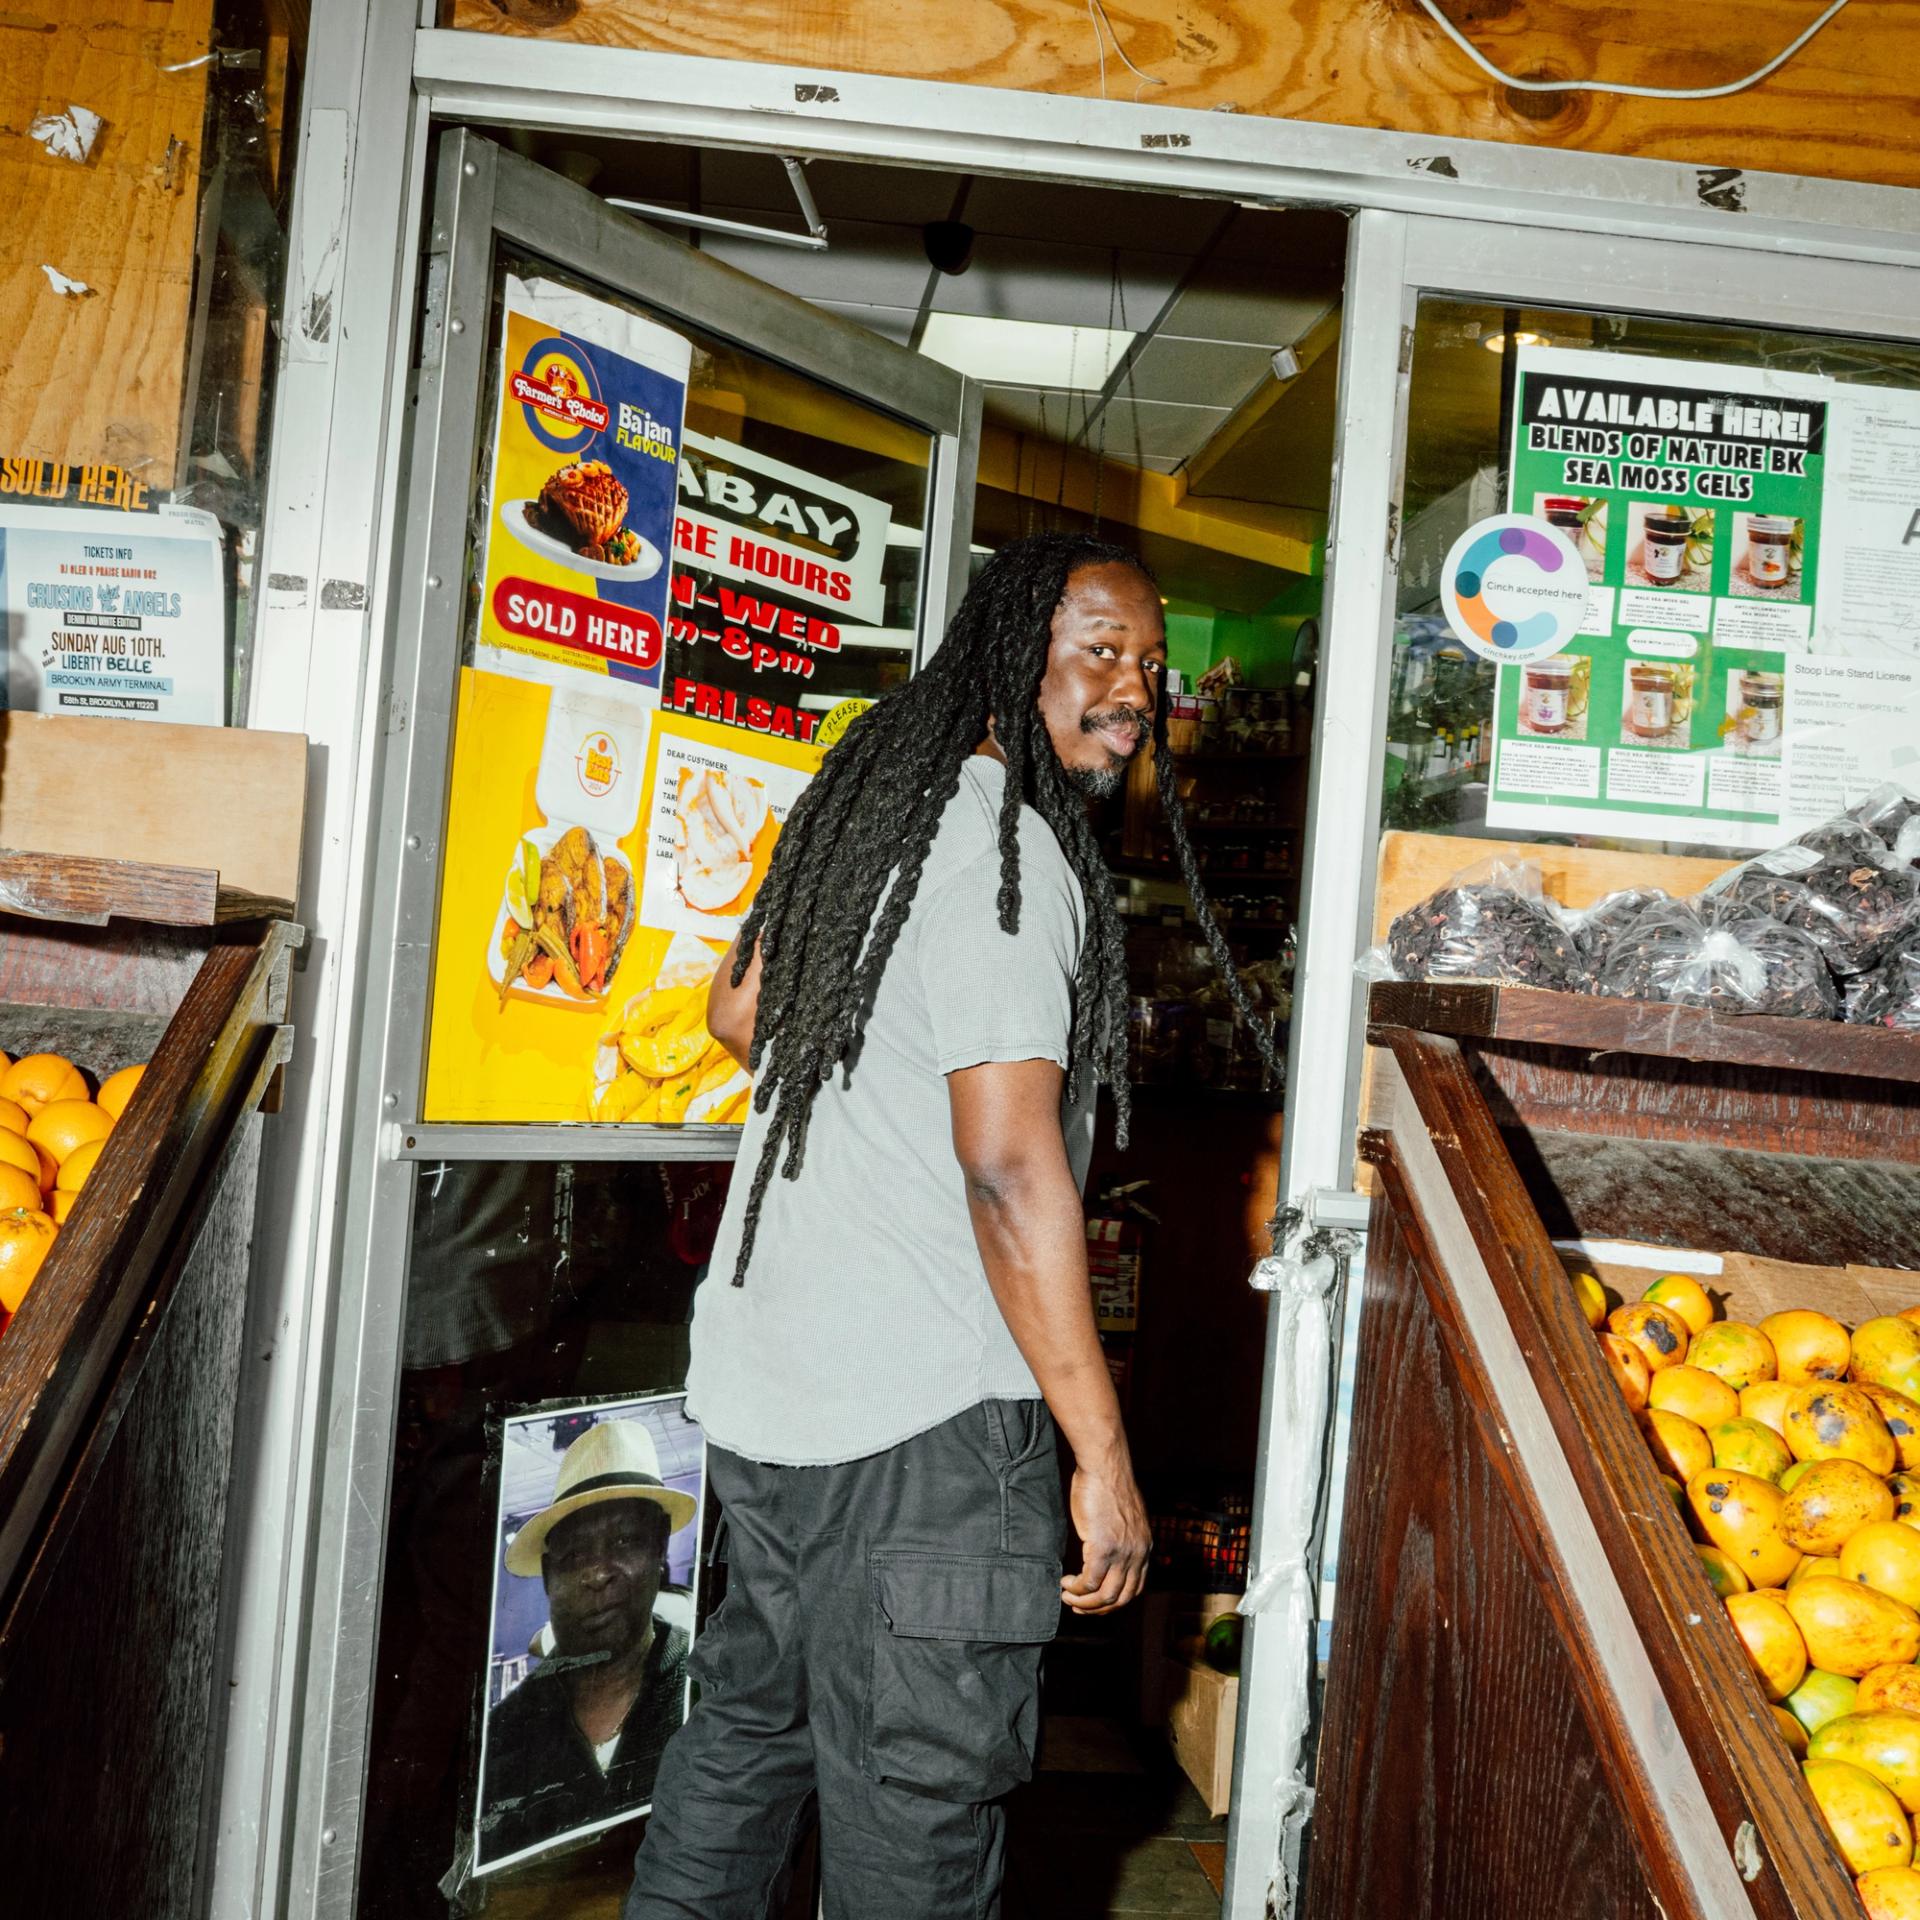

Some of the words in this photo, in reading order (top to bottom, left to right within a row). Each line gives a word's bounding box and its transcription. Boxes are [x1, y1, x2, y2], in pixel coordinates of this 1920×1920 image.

[514, 378, 562, 409] Farmer's
[566, 398, 605, 425] Choice
[1537, 387, 1713, 433] AVAILABLE
[1721, 405, 1810, 442] HERE!
[619, 402, 672, 446] Bajan
[616, 427, 677, 464] FLAVOUR
[1529, 423, 1622, 457] BLENDS
[1628, 433, 1663, 461] OF
[1666, 435, 1765, 473] NATURE
[1769, 448, 1808, 477] BK
[0, 457, 68, 499] SOLD
[1563, 458, 1615, 487] SEA
[1619, 462, 1690, 494] MOSS
[1695, 472, 1753, 501] GELS
[83, 546, 114, 559] TICKETS
[115, 548, 133, 560] INFO
[729, 536, 852, 602] HOURS
[27, 582, 93, 611] CRUISING
[123, 589, 182, 618] ANGELS
[1486, 581, 1514, 592] Cinch
[1516, 585, 1559, 598] accepted
[1561, 588, 1583, 600] here
[86, 615, 98, 626] AND
[507, 594, 577, 637] SOLD
[586, 615, 650, 659] HERE
[51, 631, 98, 653] SUNDAY
[102, 634, 126, 655] AUG
[130, 636, 165, 658] 10TH.
[62, 655, 103, 672] LIBERTY
[106, 657, 152, 674] BELLE
[1795, 665, 1822, 676] Stoop
[1825, 666, 1845, 677] Line
[1847, 668, 1874, 680] Stand
[1876, 671, 1912, 682] License
[51, 674, 95, 686] BROOKLYN
[98, 677, 121, 688] ARMY
[124, 679, 167, 691] TERMINAL
[126, 699, 135, 708] NY
[826, 702, 860, 732] PLEASE
[667, 749, 685, 760] DEAR
[661, 806, 671, 816] ON
